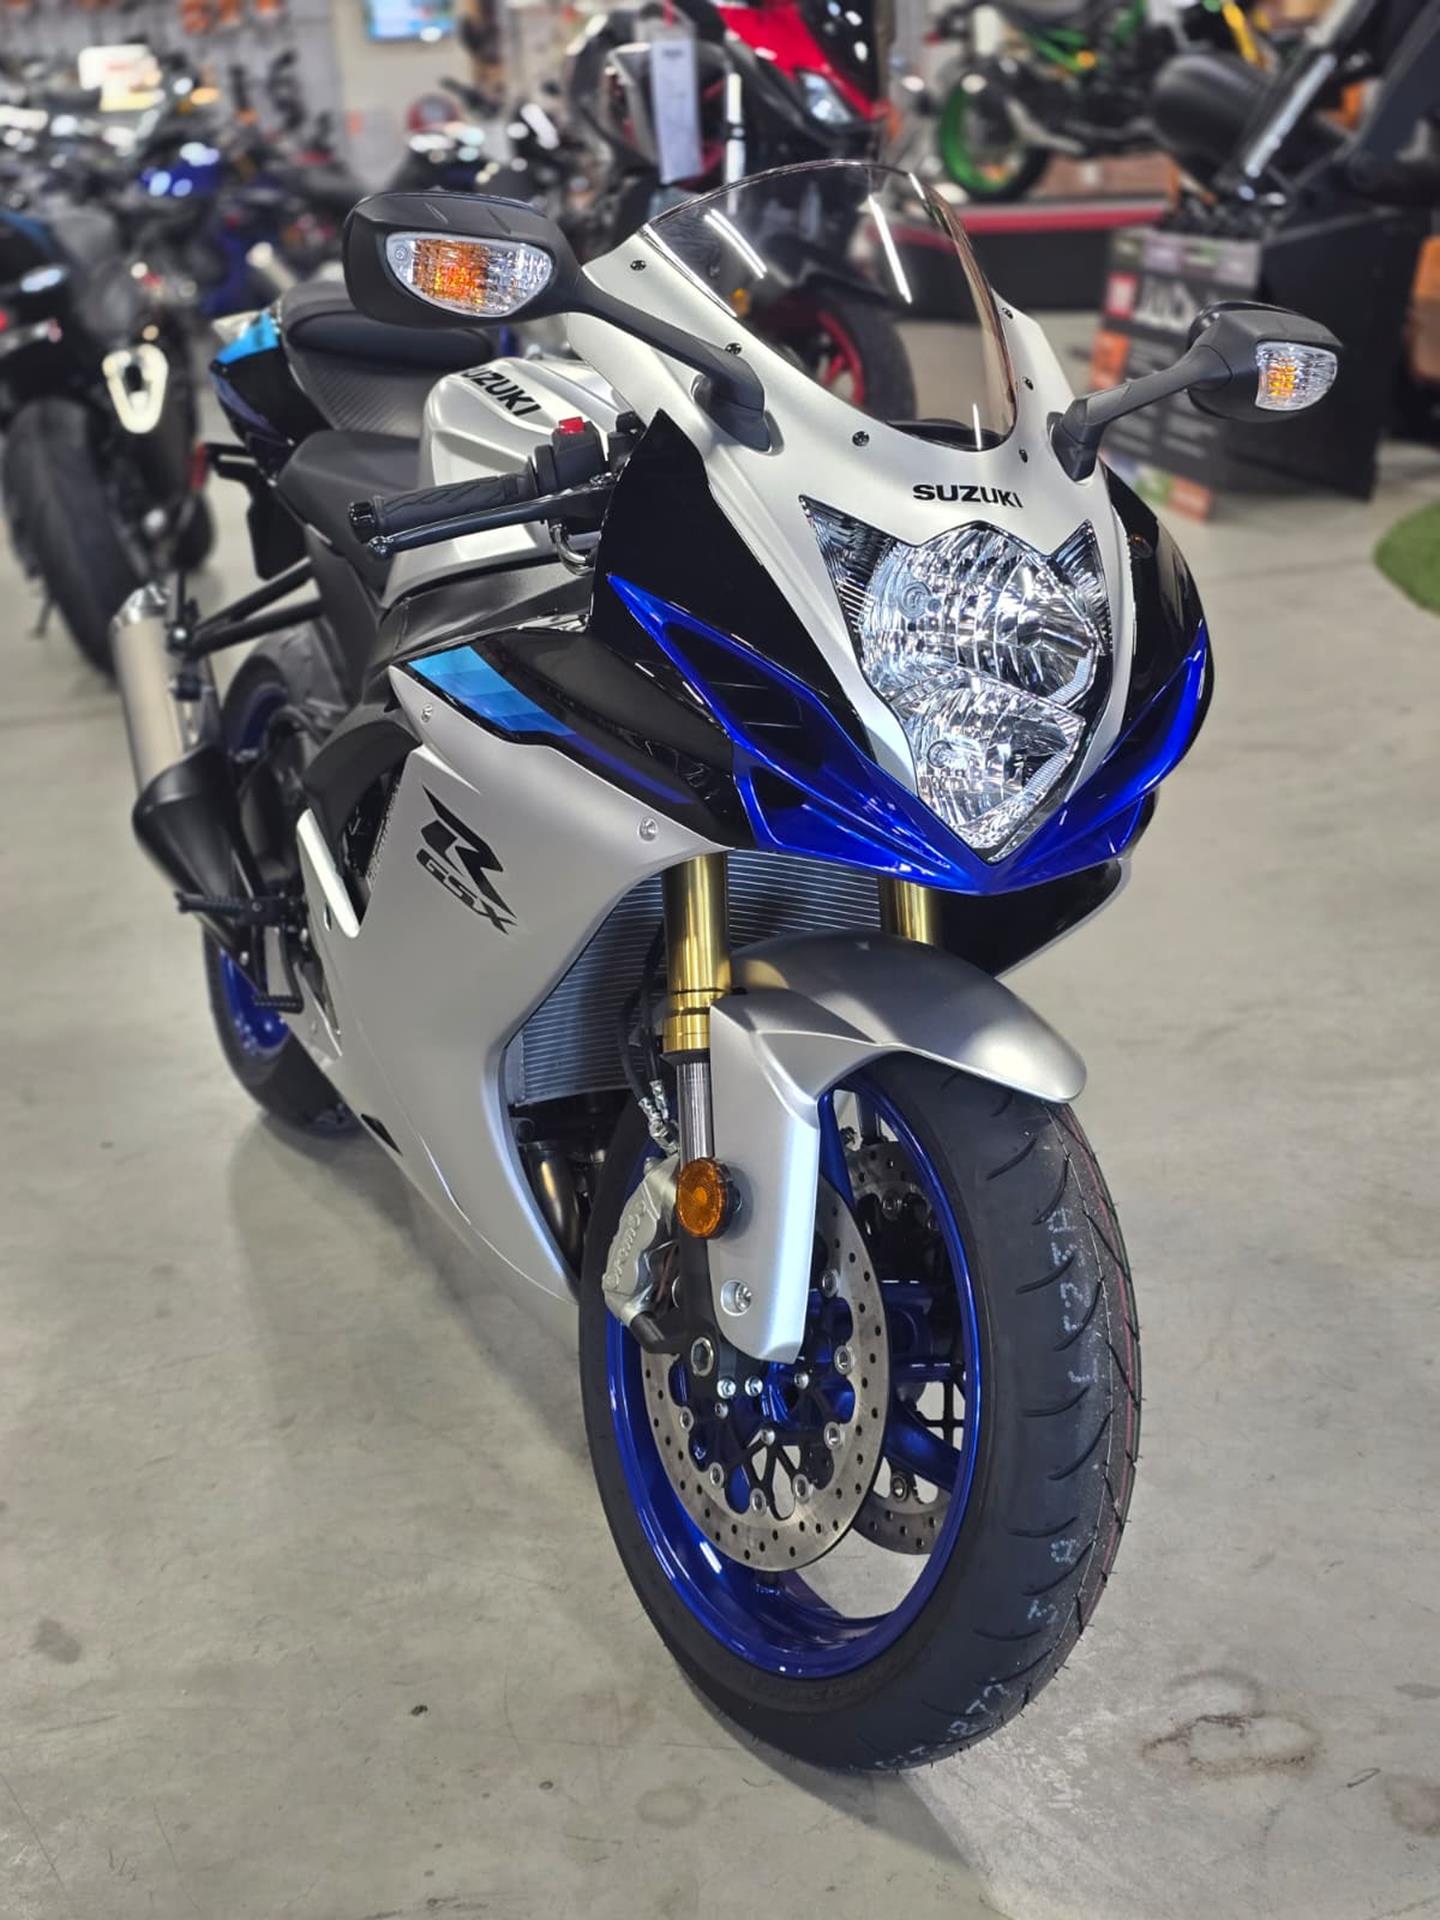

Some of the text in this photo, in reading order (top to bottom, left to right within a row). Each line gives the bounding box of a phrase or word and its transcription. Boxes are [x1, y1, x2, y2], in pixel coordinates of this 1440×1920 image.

[461, 368, 542, 416] UZUKI
[912, 484, 1024, 509] SUZUKI
[421, 784, 518, 919] R
[416, 848, 518, 935] GSX
